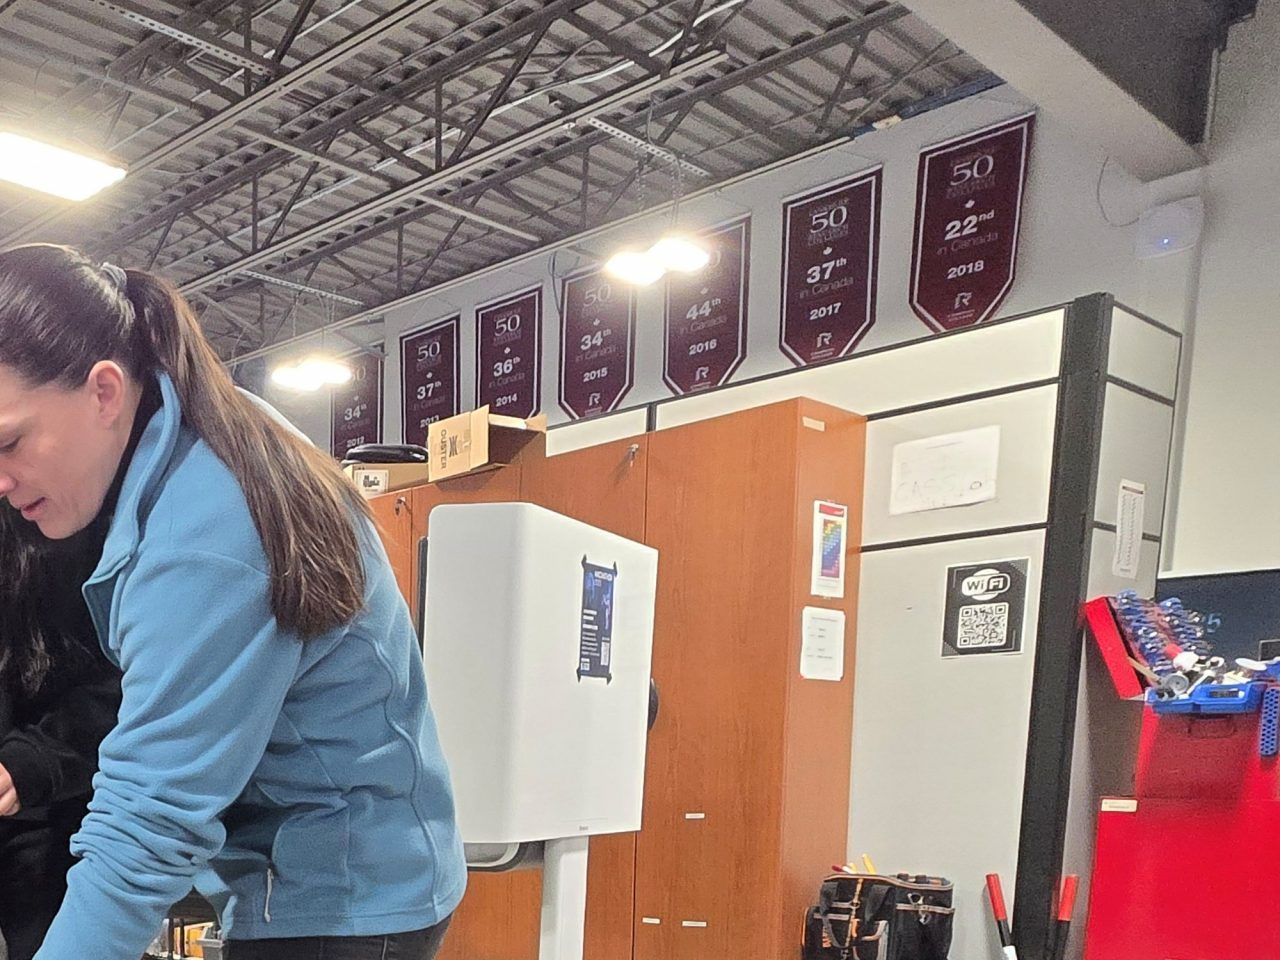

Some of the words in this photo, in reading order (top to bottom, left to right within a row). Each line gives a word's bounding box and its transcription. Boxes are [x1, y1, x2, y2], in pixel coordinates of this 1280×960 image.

[950, 155, 994, 186] 50
[810, 205, 847, 234] 50
[944, 209, 995, 241] 22nd
[806, 257, 847, 284] 37th
[947, 260, 984, 280] 2018
[583, 284, 611, 307] 50
[686, 298, 721, 320] 44th
[809, 302, 842, 320] 2017
[494, 314, 520, 337] 50
[580, 328, 612, 351] 34th
[689, 339, 717, 356] 2016
[417, 341, 440, 362] 50
[493, 356, 521, 377] 36th
[583, 367, 608, 383] 2015
[417, 381, 442, 400] 37th
[495, 393, 518, 407] 2014
[440, 429, 448, 470] OUSTER
